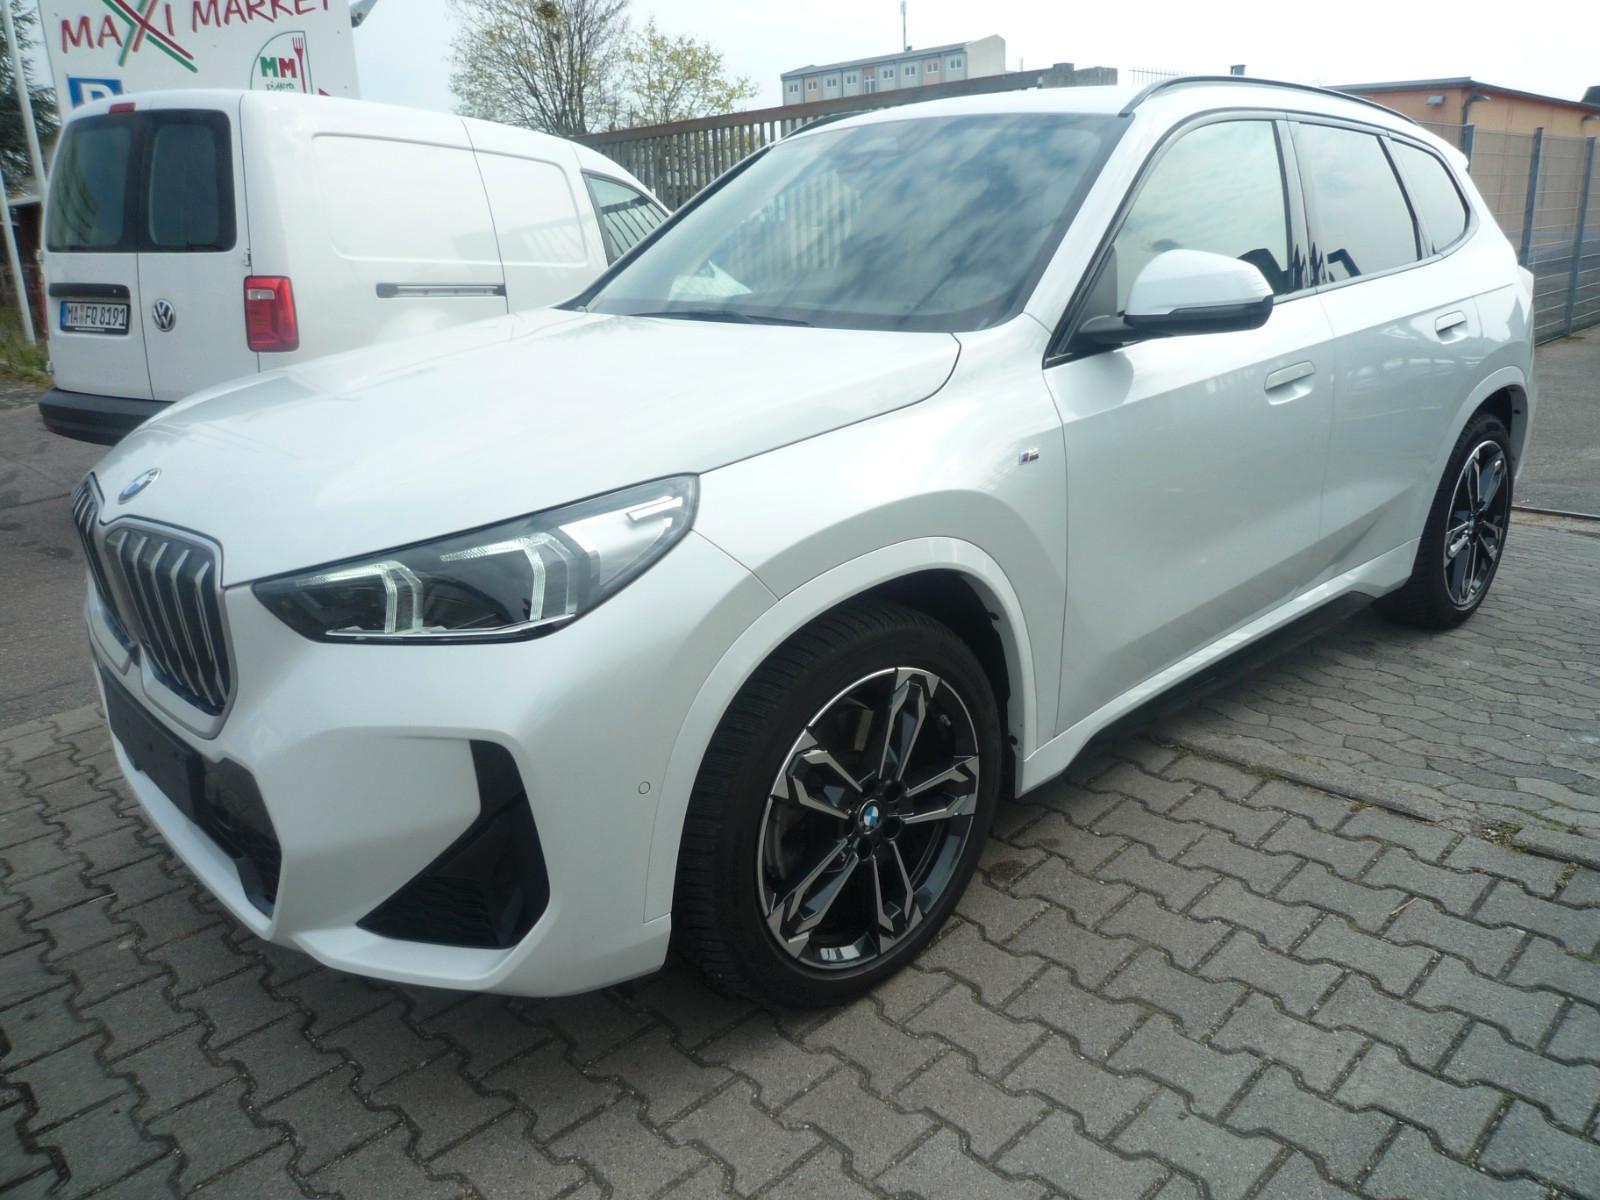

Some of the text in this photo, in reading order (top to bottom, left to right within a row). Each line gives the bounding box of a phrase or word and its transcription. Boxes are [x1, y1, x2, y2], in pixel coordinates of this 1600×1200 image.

[61, 0, 198, 73] MAXI
[260, 56, 298, 79] MM
[99, 306, 126, 327] 8191
